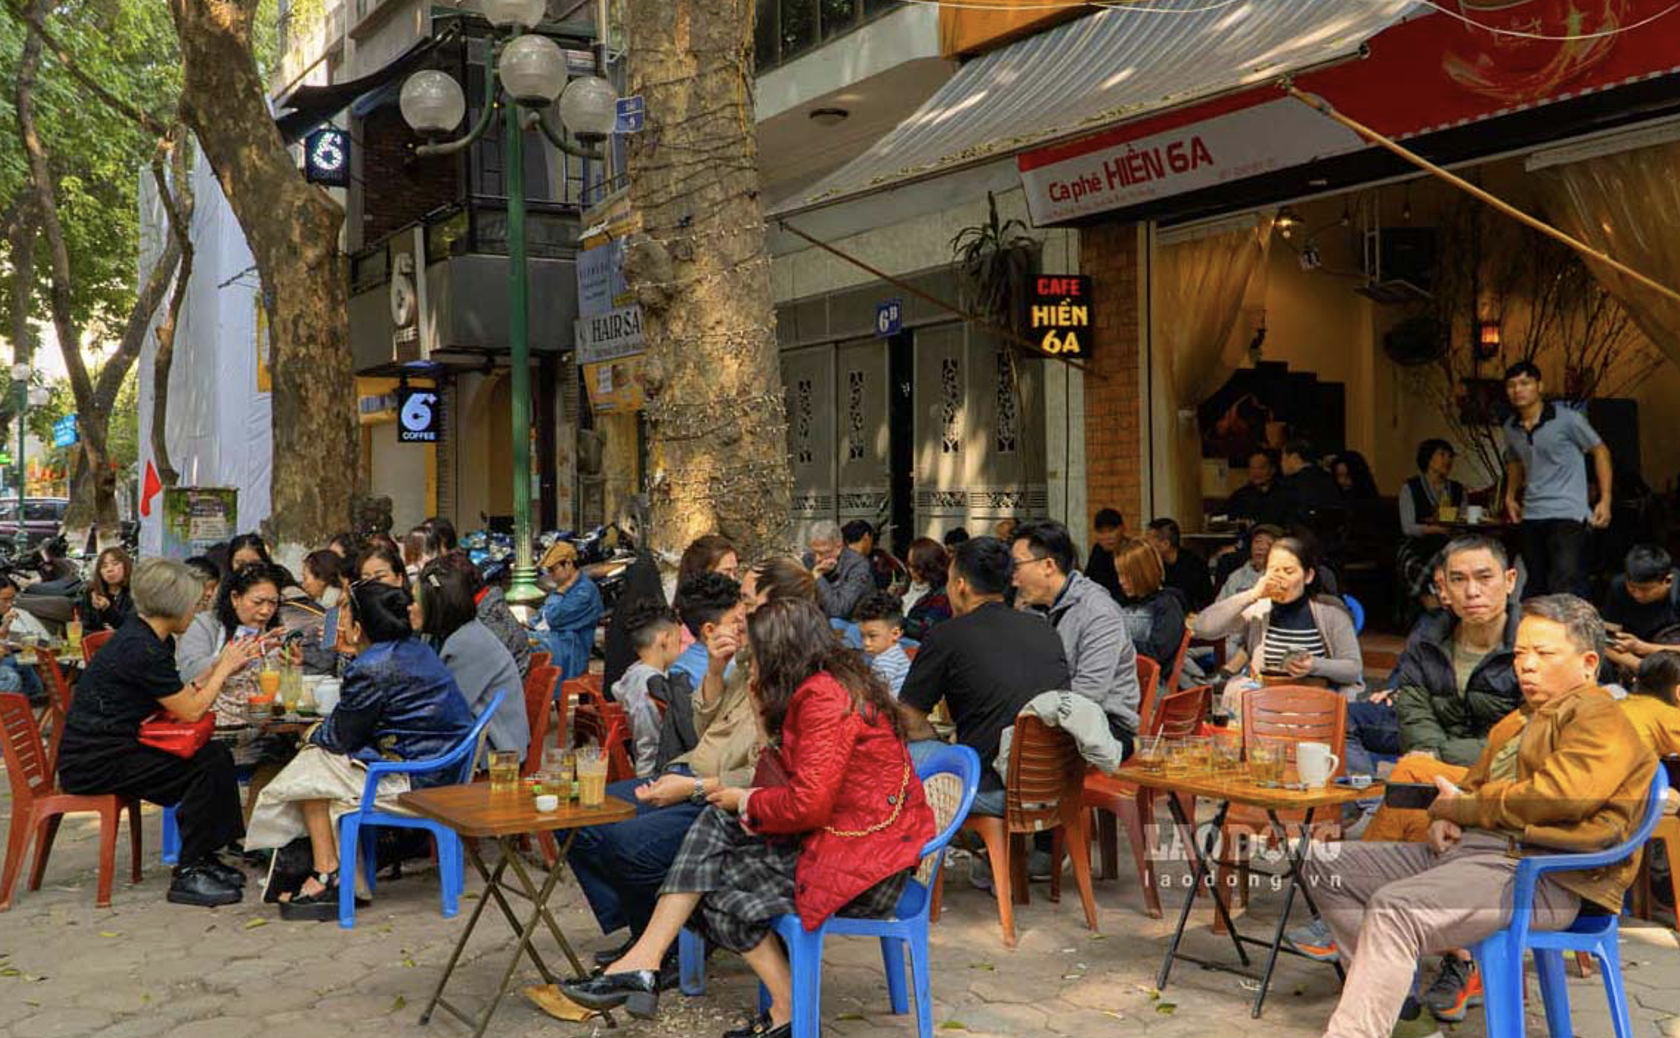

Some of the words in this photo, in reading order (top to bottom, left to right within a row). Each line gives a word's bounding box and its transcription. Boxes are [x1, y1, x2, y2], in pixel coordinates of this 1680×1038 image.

[313, 132, 342, 170] 6
[1166, 136, 1214, 174] 6A
[1037, 278, 1081, 295] CAFE
[592, 314, 623, 343] HAIR
[623, 308, 644, 336] SA
[1031, 297, 1088, 328] HIỀN
[1041, 329, 1081, 354] 6A
[401, 392, 437, 432] 6
[402, 431, 436, 441] COFFEE
